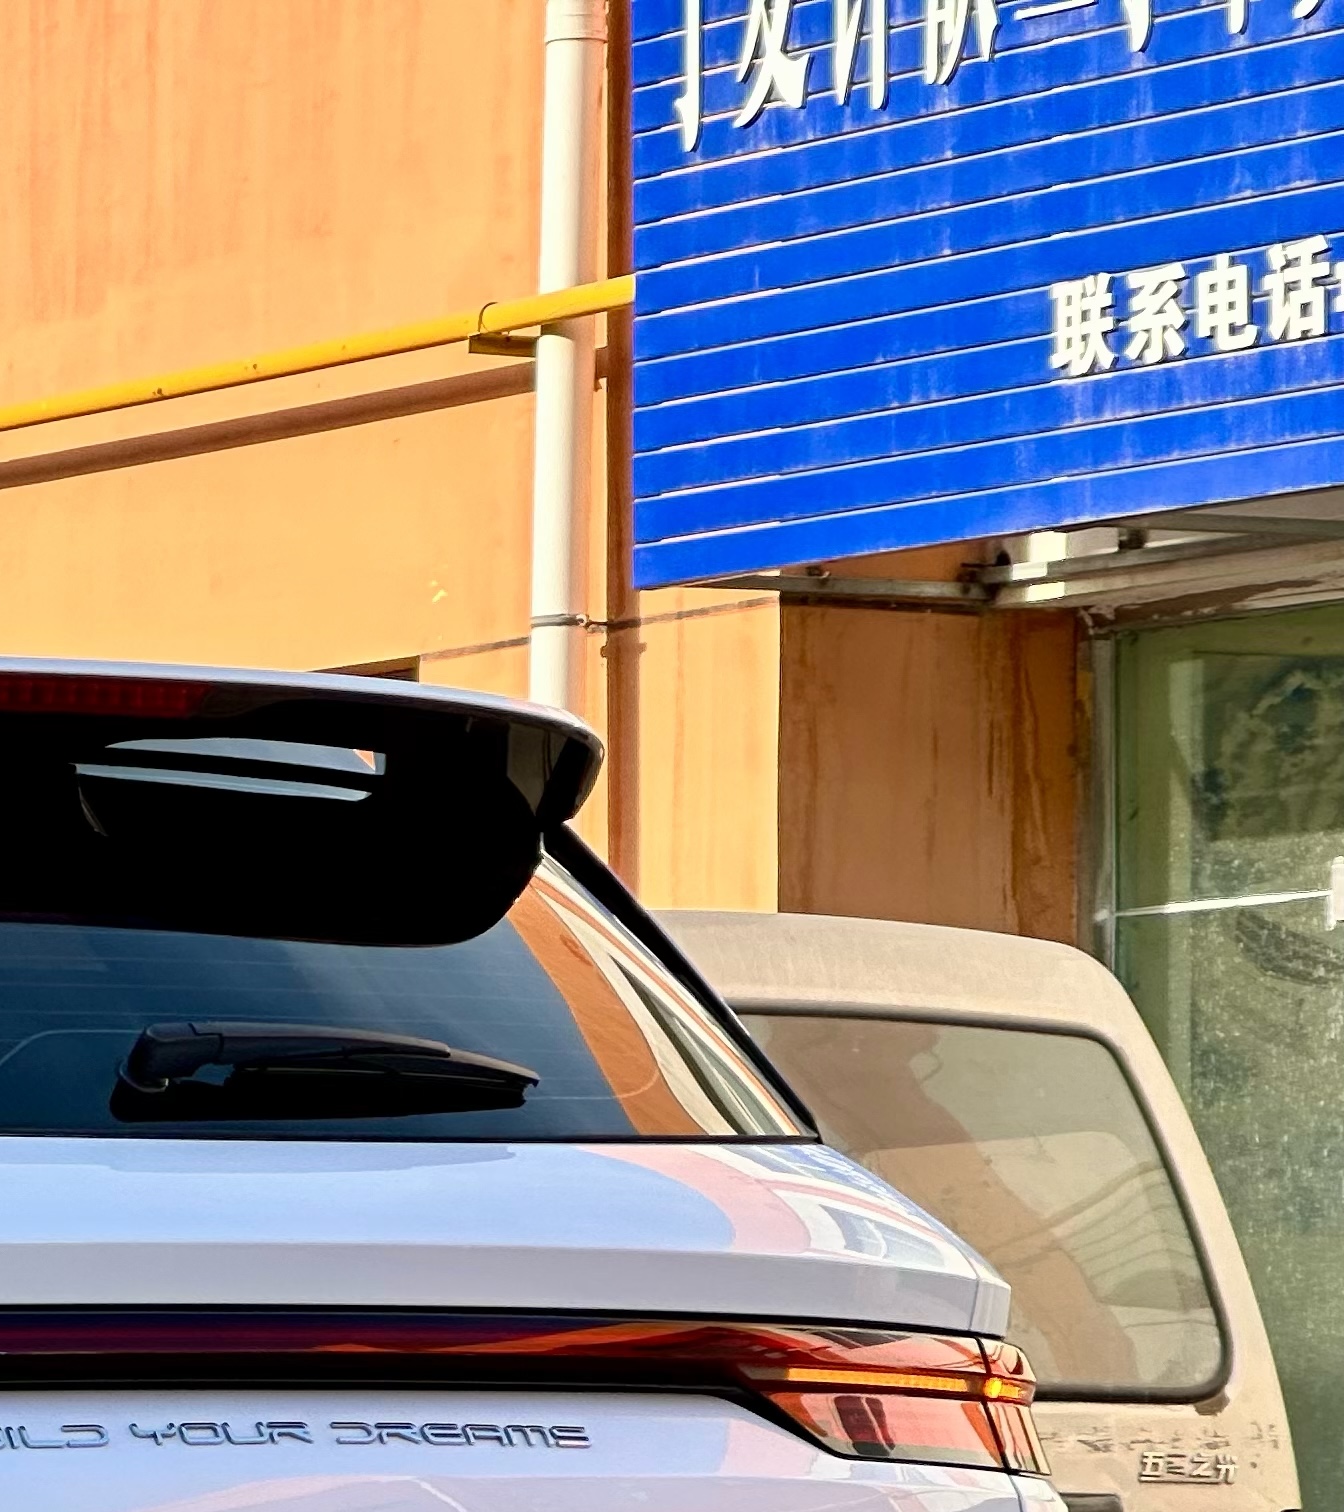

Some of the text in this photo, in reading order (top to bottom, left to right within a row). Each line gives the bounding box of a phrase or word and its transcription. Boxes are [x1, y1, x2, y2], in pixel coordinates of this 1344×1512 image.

[1050, 234, 1344, 377] 联系电话
[128, 1420, 315, 1447] YOUR
[328, 1420, 593, 1450] DREAMS
